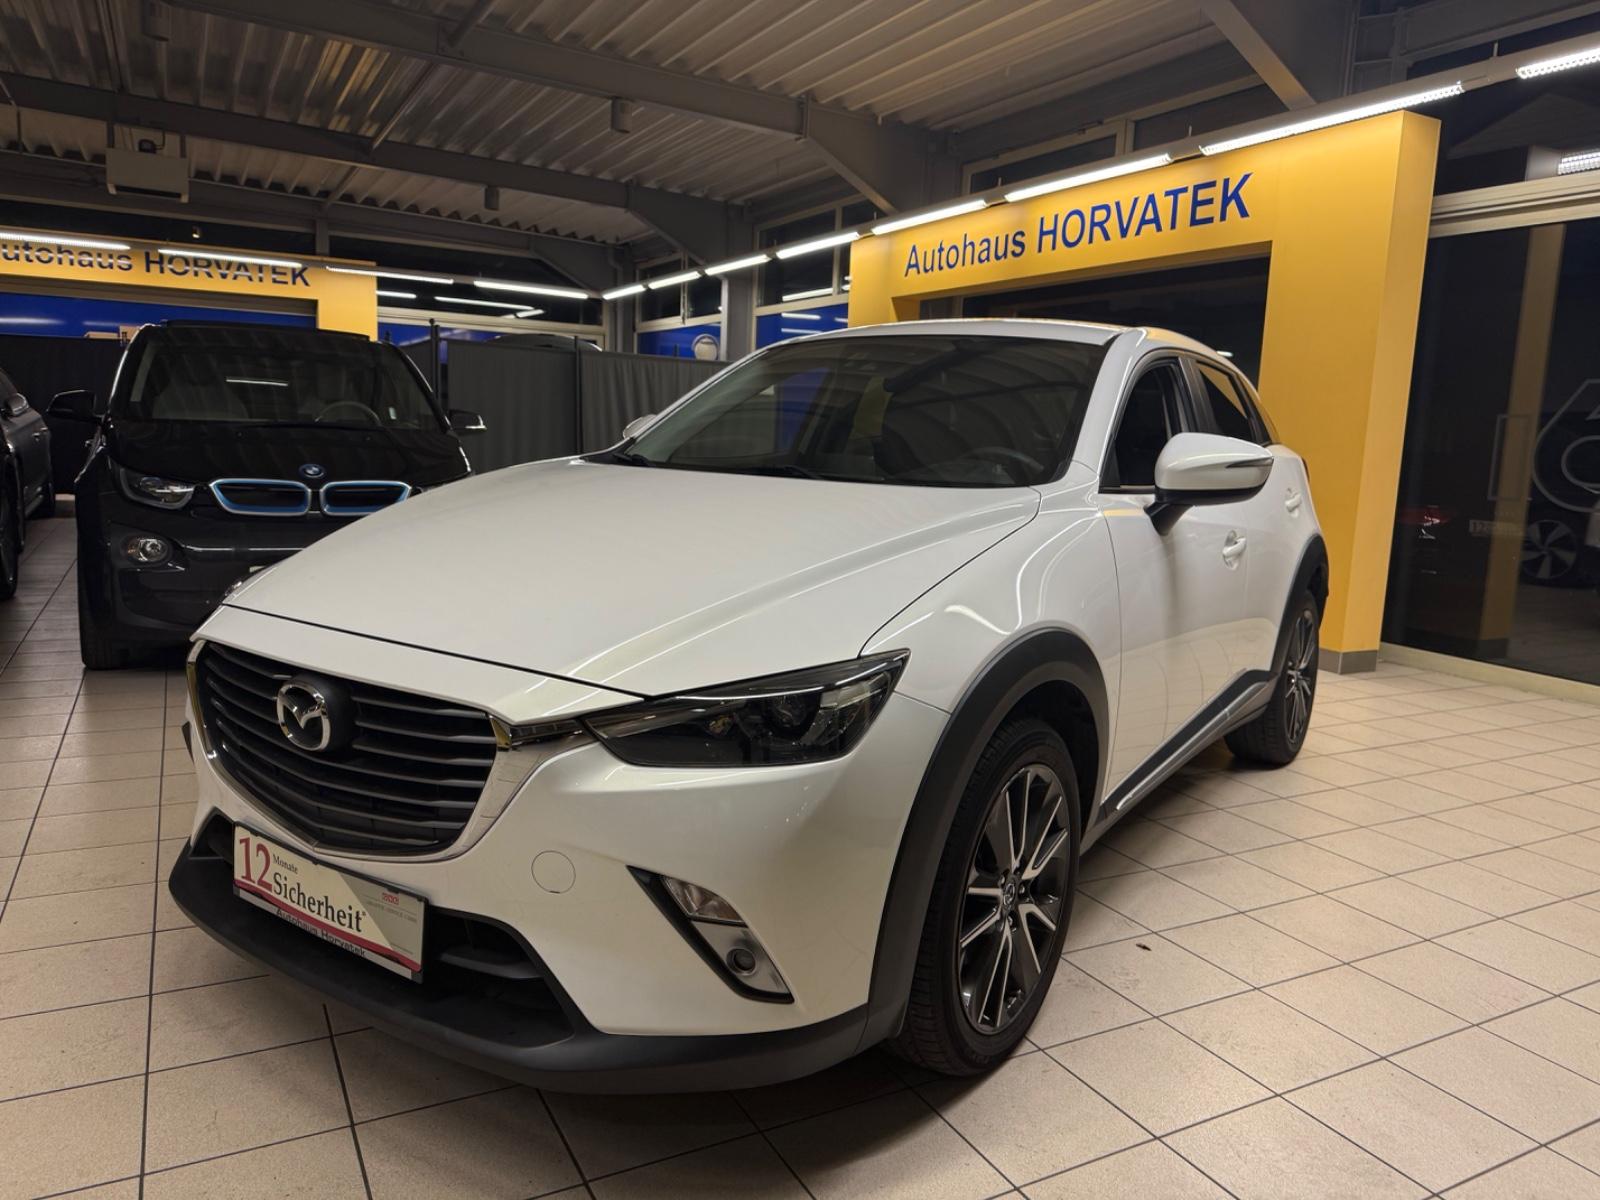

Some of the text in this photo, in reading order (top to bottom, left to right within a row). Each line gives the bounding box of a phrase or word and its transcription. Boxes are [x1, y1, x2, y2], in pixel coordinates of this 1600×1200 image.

[904, 173, 1253, 277] Autohaus HORVATEK
[1, 241, 133, 271] utohaus
[240, 837, 273, 893] 12
[273, 853, 298, 873] Monate
